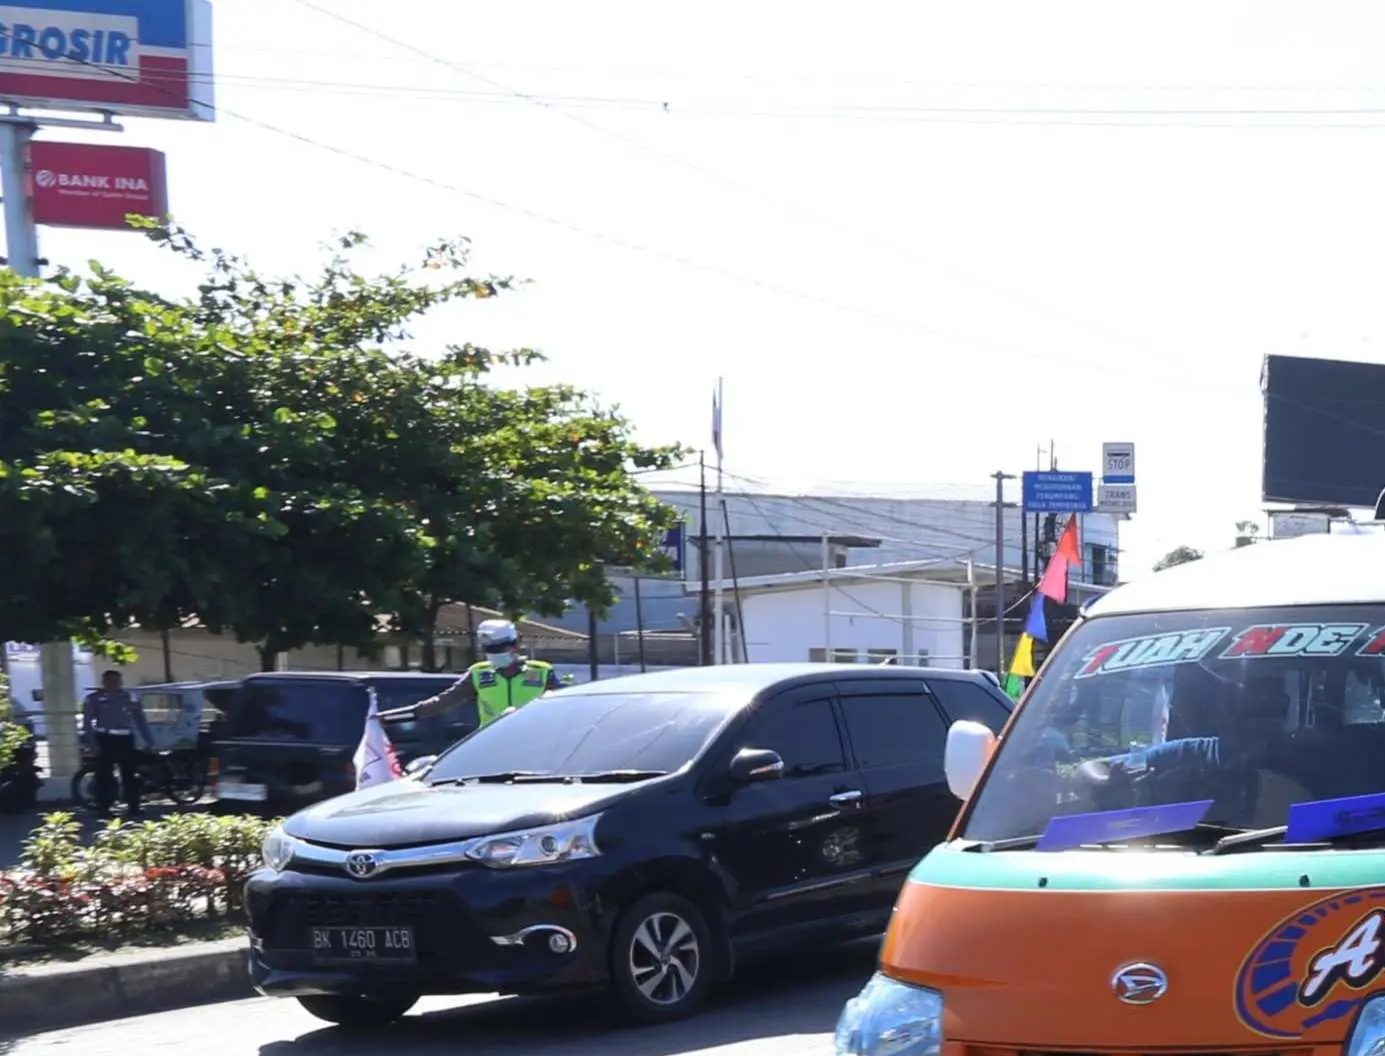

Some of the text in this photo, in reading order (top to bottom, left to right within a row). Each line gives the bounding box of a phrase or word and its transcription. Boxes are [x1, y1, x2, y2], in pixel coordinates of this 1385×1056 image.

[58, 174, 148, 190] BANK INA
[1108, 459, 1130, 471] STOP
[1227, 625, 1364, 656] NDE
[313, 930, 410, 949] BK 1460 ACB
